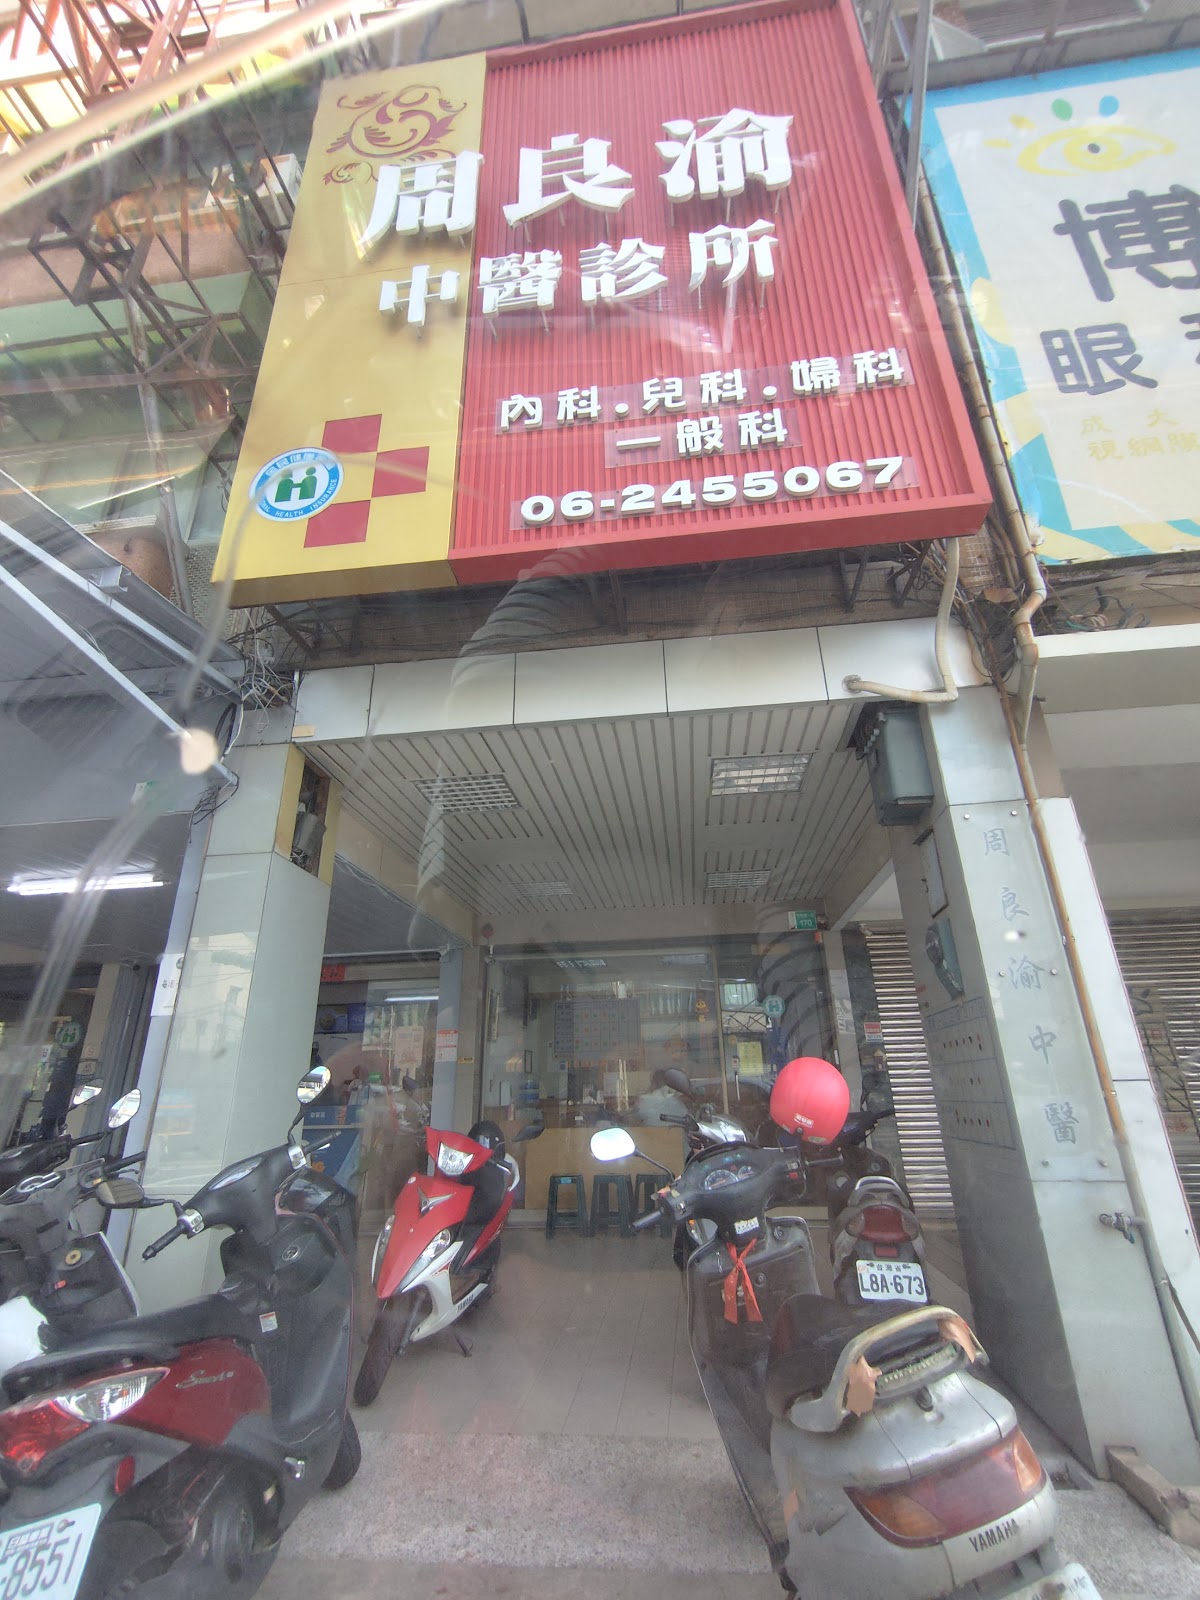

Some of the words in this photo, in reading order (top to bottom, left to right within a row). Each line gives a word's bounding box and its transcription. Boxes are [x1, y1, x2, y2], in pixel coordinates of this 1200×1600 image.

[359, 107, 795, 246] 周良渝
[379, 218, 779, 327] 中醫診所
[616, 408, 788, 457] 一般科
[310, 478, 337, 511] INSURANCE
[520, 455, 904, 526] 06-2455067
[983, 827, 1080, 1145] 周良渝中醫
[859, 1272, 925, 1296] L8A-673
[968, 1518, 1020, 1553] YAMAHA
